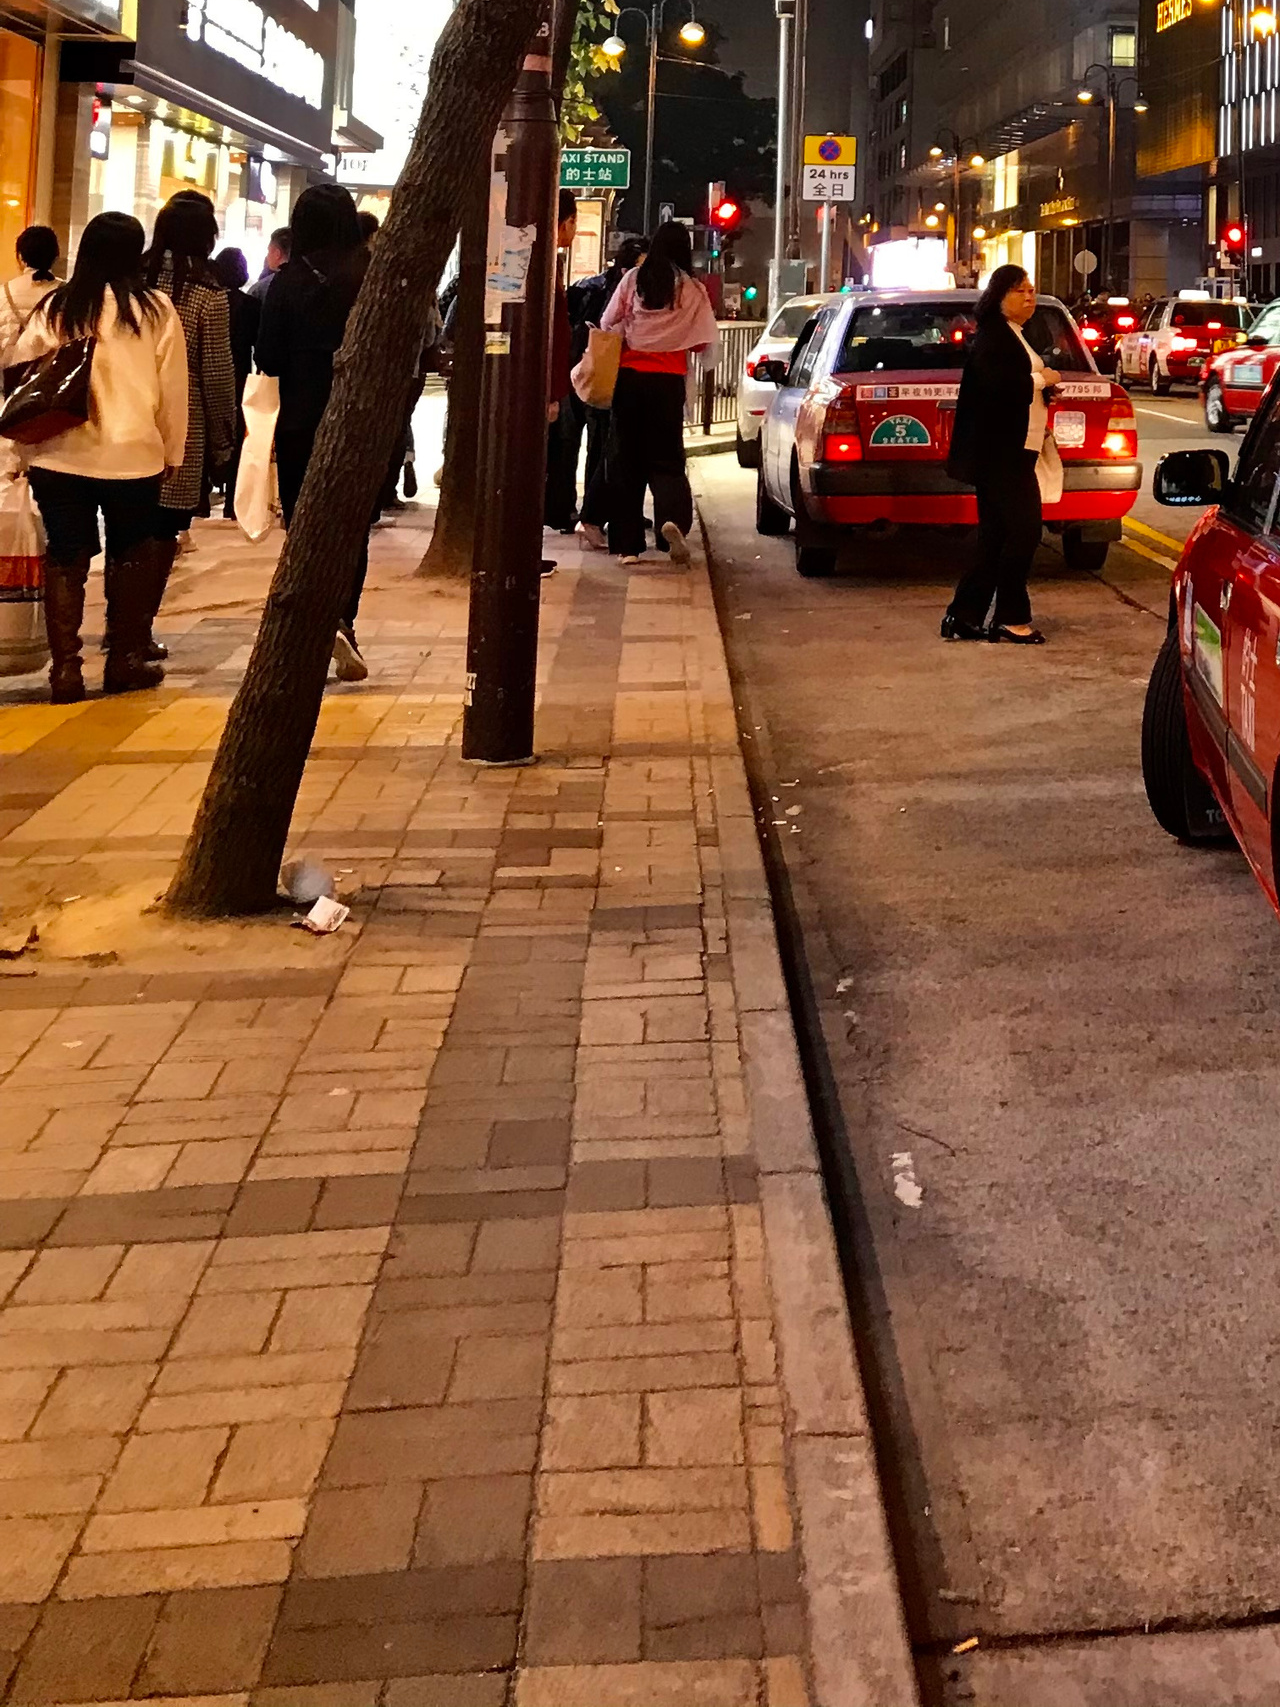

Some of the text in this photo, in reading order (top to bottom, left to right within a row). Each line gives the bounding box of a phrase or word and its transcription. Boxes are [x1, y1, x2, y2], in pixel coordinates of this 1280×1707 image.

[560, 154, 625, 163] AXI STAND
[566, 167, 612, 181] 的士站
[809, 169, 849, 180] 24 hrs
[812, 183, 844, 196] 全日
[895, 425, 907, 437] 5
